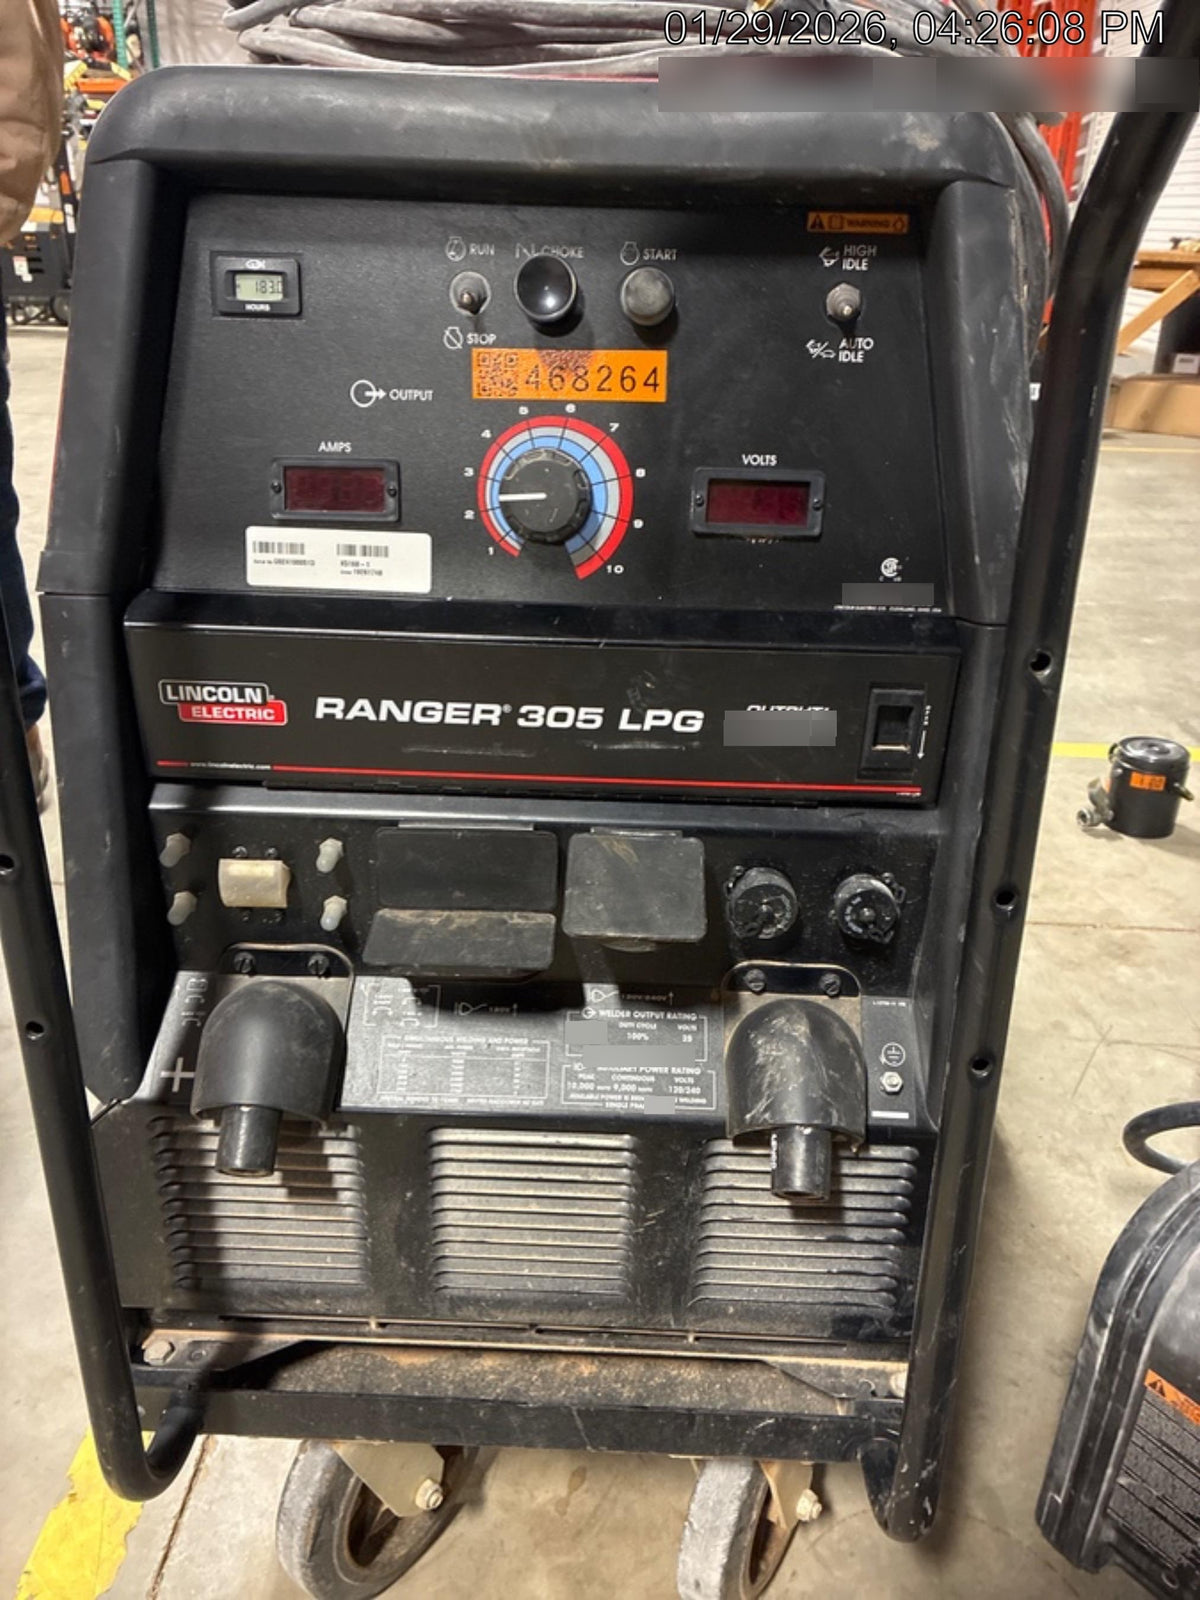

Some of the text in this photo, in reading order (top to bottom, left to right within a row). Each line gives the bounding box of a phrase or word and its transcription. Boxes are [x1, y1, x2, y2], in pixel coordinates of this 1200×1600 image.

[469, 243, 495, 256] RUN
[543, 246, 584, 259] CHOKE
[642, 248, 677, 261] START
[842, 244, 878, 257] HIGH
[842, 258, 869, 271] IDLE
[466, 333, 497, 345] STOP
[838, 337, 874, 350] AUTO
[838, 350, 865, 363] IDLE
[524, 364, 660, 393] 468264
[389, 388, 434, 402] OUTPUT
[518, 406, 529, 415] 5
[564, 402, 576, 413] 6
[480, 429, 491, 438] 4
[609, 423, 620, 432] 7
[317, 441, 352, 453] AMPS
[741, 454, 778, 466] VOLTS
[463, 467, 474, 476] 3
[635, 468, 646, 477] 8
[463, 510, 475, 519] 2
[633, 519, 644, 528] 9
[488, 547, 494, 555] 1
[606, 565, 624, 574] 10
[166, 684, 263, 704] LINCOLN
[191, 705, 275, 721] ELECTRIC
[516, 705, 605, 730] 305
[618, 708, 705, 733] LPG
[598, 1010, 697, 1021] WELDER OUTPUT RATING
[639, 1066, 669, 1074] POWER
[671, 1067, 702, 1075] RATING
